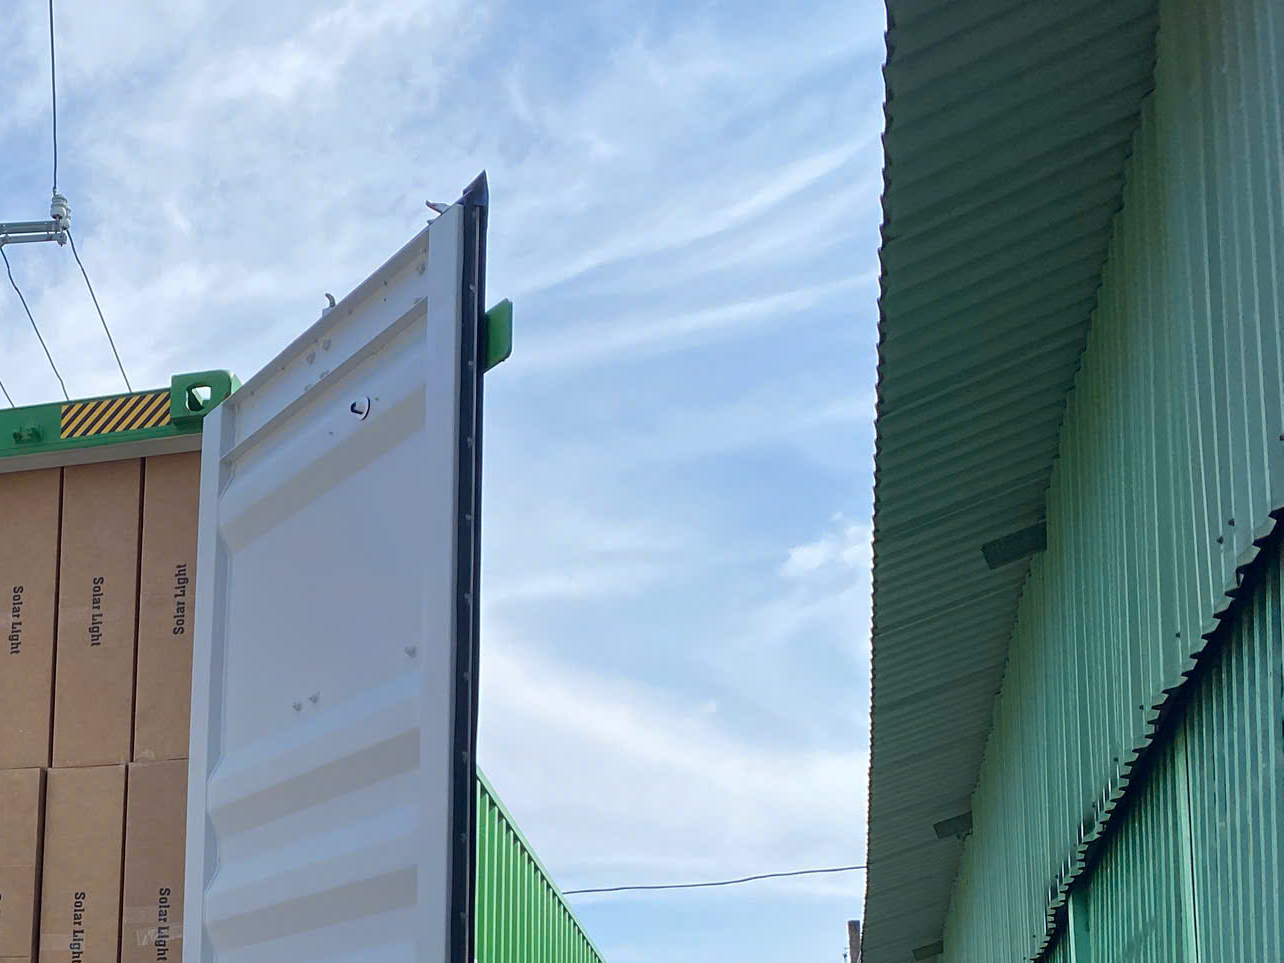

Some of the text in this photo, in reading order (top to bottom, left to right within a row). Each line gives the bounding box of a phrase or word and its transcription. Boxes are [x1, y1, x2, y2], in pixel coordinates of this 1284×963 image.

[8, 585, 24, 655] Solar Light
[88, 576, 105, 647] Solar Light
[172, 563, 189, 635] Solar Light
[69, 891, 86, 963] Solar Light
[154, 887, 171, 961] Solar Light
